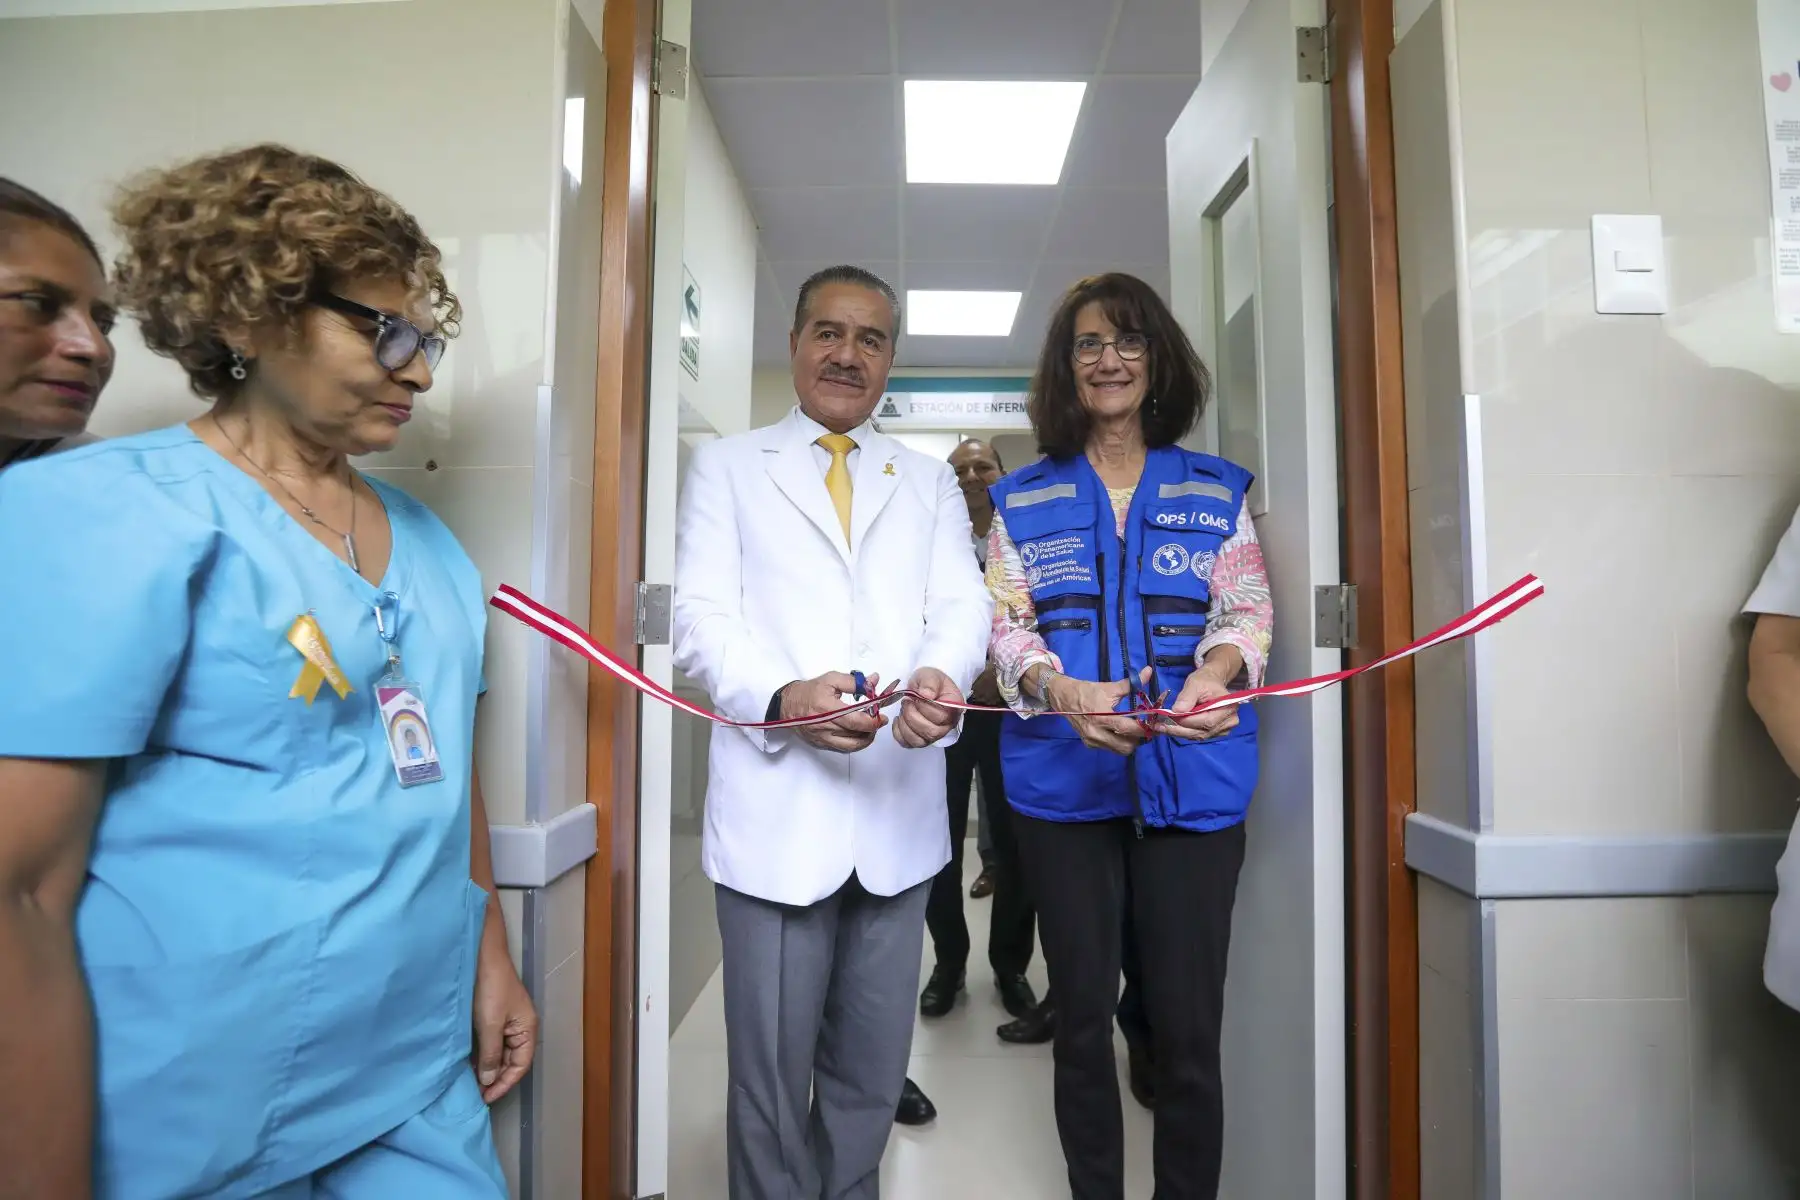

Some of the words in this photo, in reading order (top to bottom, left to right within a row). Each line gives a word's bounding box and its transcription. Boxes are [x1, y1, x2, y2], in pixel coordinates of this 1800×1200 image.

[909, 400, 963, 413] ESTACIÓN
[966, 402, 981, 413] DE
[1156, 513, 1187, 525] OPS
[1190, 511, 1196, 524] /
[1199, 512, 1230, 531] OMS
[1038, 536, 1081, 548] Organización
[1039, 543, 1085, 554] Panamericana
[1055, 548, 1074, 556] Salud
[1041, 558, 1077, 571] Organización
[1075, 565, 1090, 573] Salud
[1061, 573, 1092, 582] Américas
